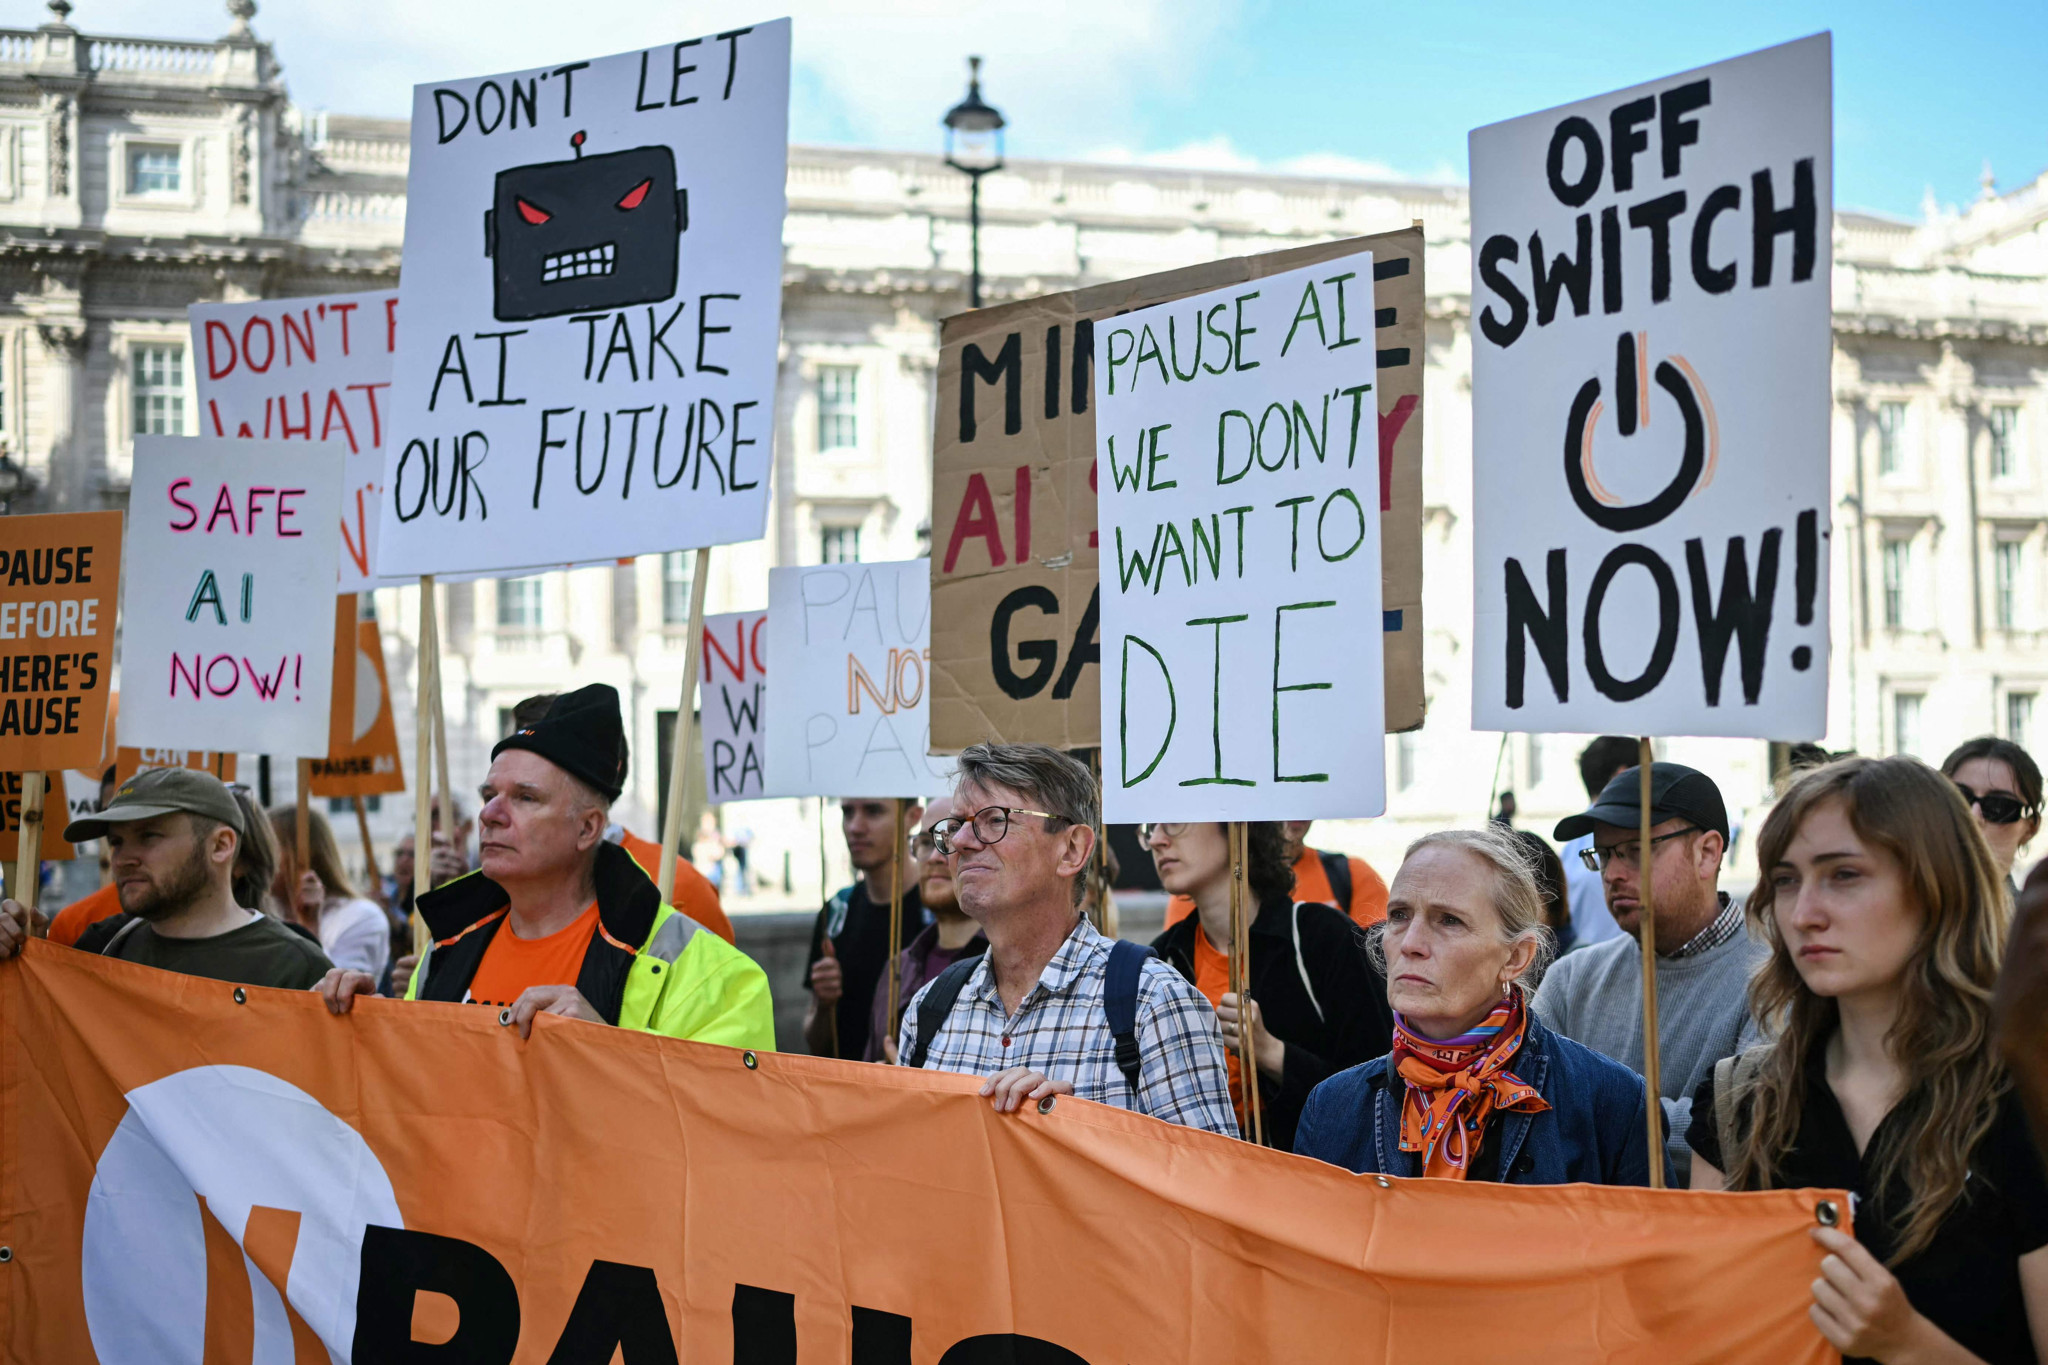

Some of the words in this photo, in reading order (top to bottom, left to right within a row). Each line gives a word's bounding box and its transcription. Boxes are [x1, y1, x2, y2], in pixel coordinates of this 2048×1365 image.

[434, 61, 591, 144] DON'T
[636, 27, 754, 112] LET
[1546, 76, 1712, 208] OFF
[1478, 156, 1816, 348] SWITCH
[205, 302, 358, 380] DON'T
[429, 329, 528, 411] AI
[568, 293, 741, 383] TAKE
[1106, 290, 1260, 395] PAUSE
[1281, 271, 1361, 357] AI
[394, 430, 488, 522] OUR
[533, 397, 759, 509] FUTURE
[1107, 423, 1177, 493] WE
[1217, 383, 1372, 485] DON'T
[167, 476, 306, 538] SAFE
[943, 464, 1031, 573] AI
[1115, 505, 1254, 595] WANT
[1276, 488, 1365, 572] TO
[0, 598, 99, 640] EFORE
[186, 568, 253, 626] AI
[801, 568, 930, 646] PAU
[1503, 508, 1818, 710] NOW!
[0, 696, 81, 736] AUSE
[169, 652, 303, 702] NOW!
[848, 648, 931, 716] NO
[1120, 600, 1337, 788] DIE
[713, 739, 764, 795] RA
